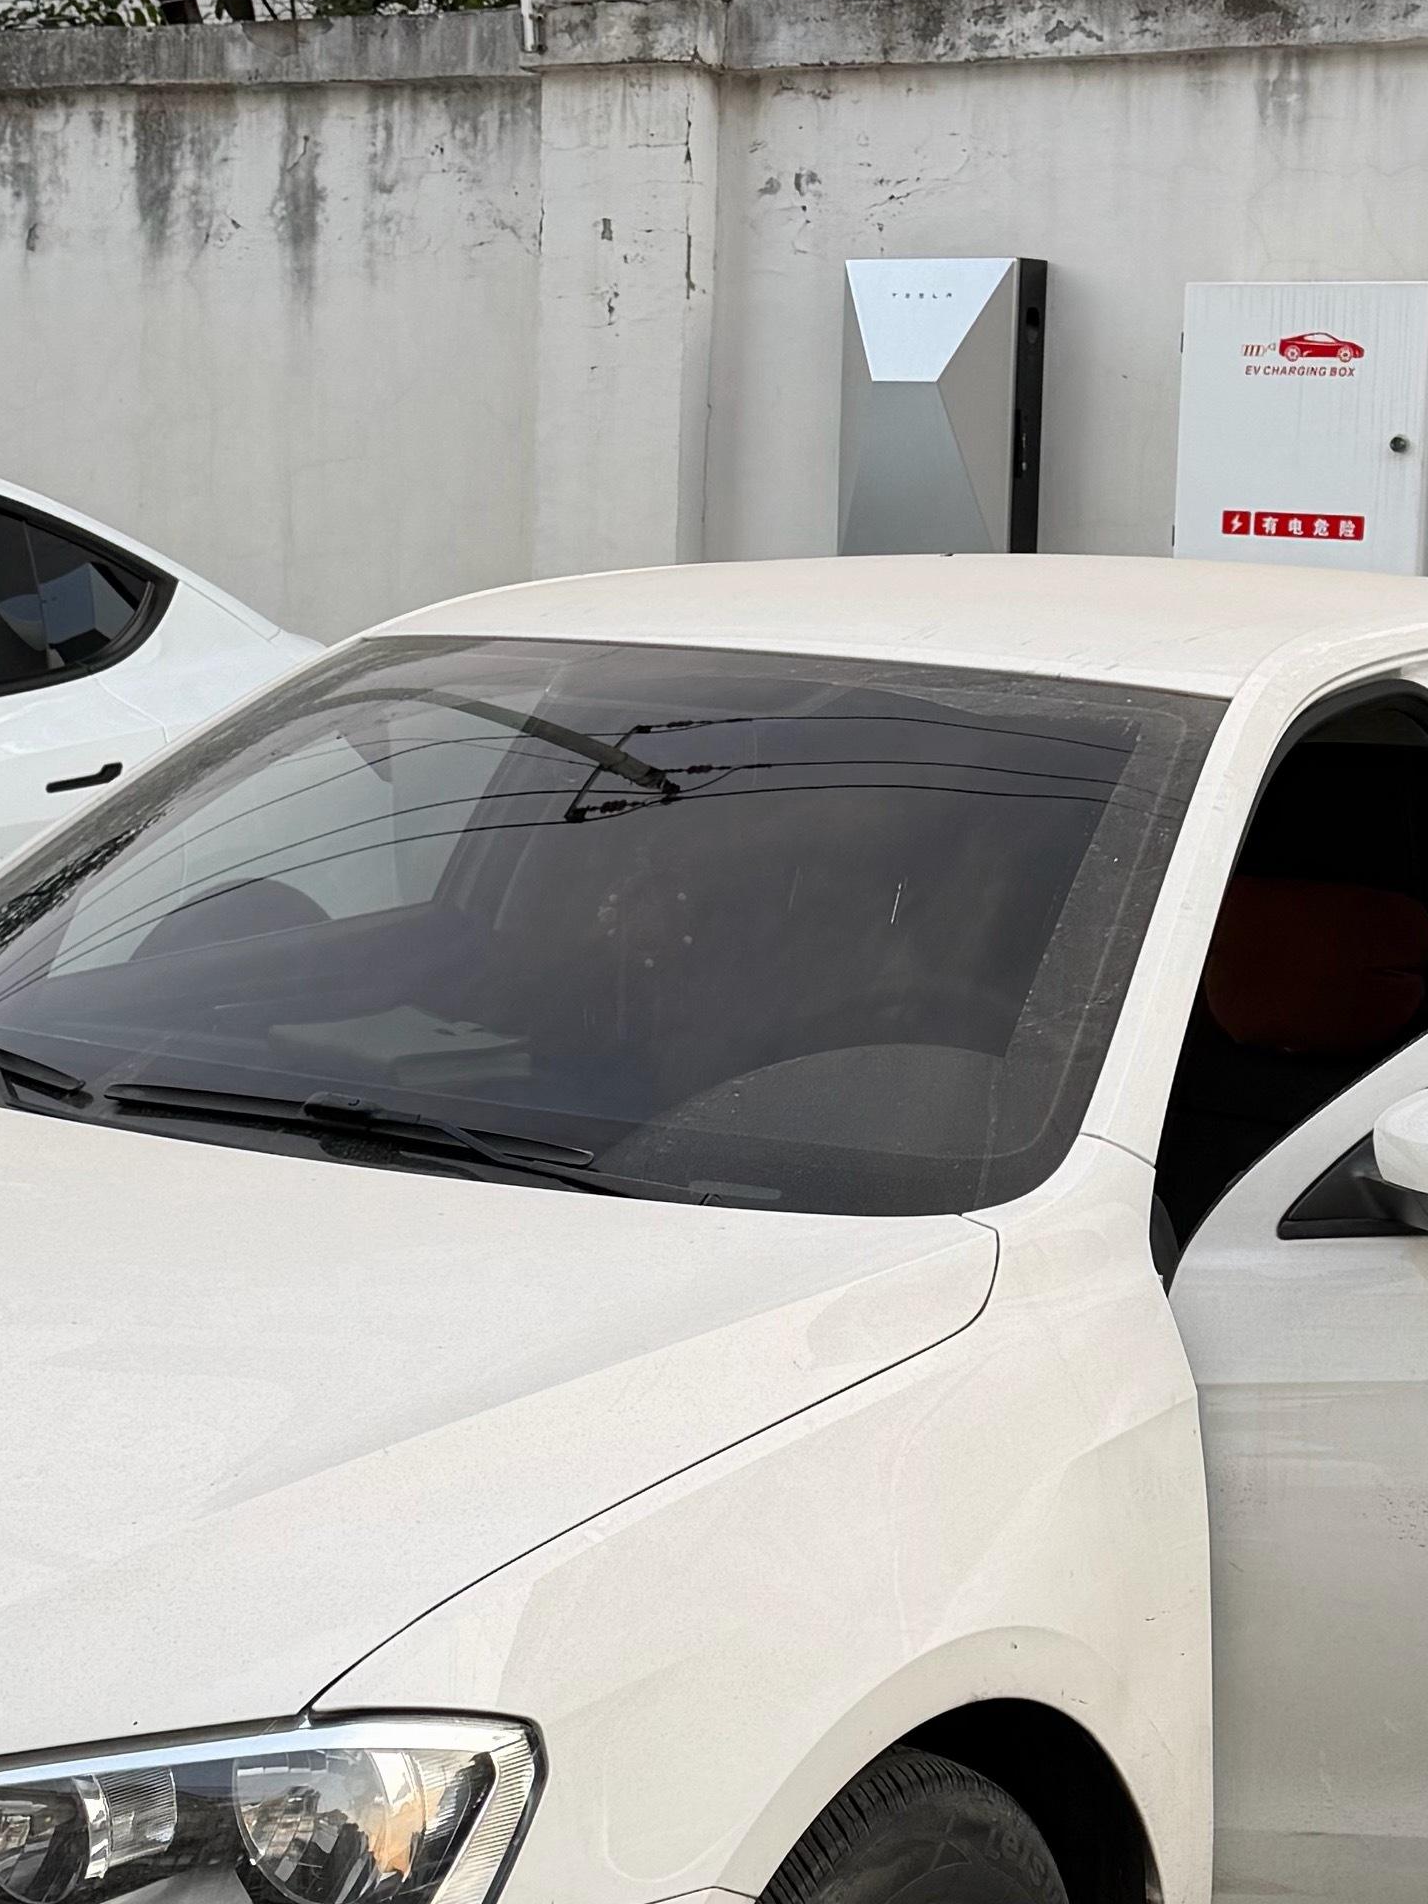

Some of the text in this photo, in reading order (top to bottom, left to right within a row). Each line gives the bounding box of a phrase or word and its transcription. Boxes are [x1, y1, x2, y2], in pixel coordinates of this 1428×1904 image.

[892, 292, 952, 300] TESLA
[1245, 365, 1356, 377] EV CHARGING BOX
[1261, 516, 1356, 538] 有电危险
